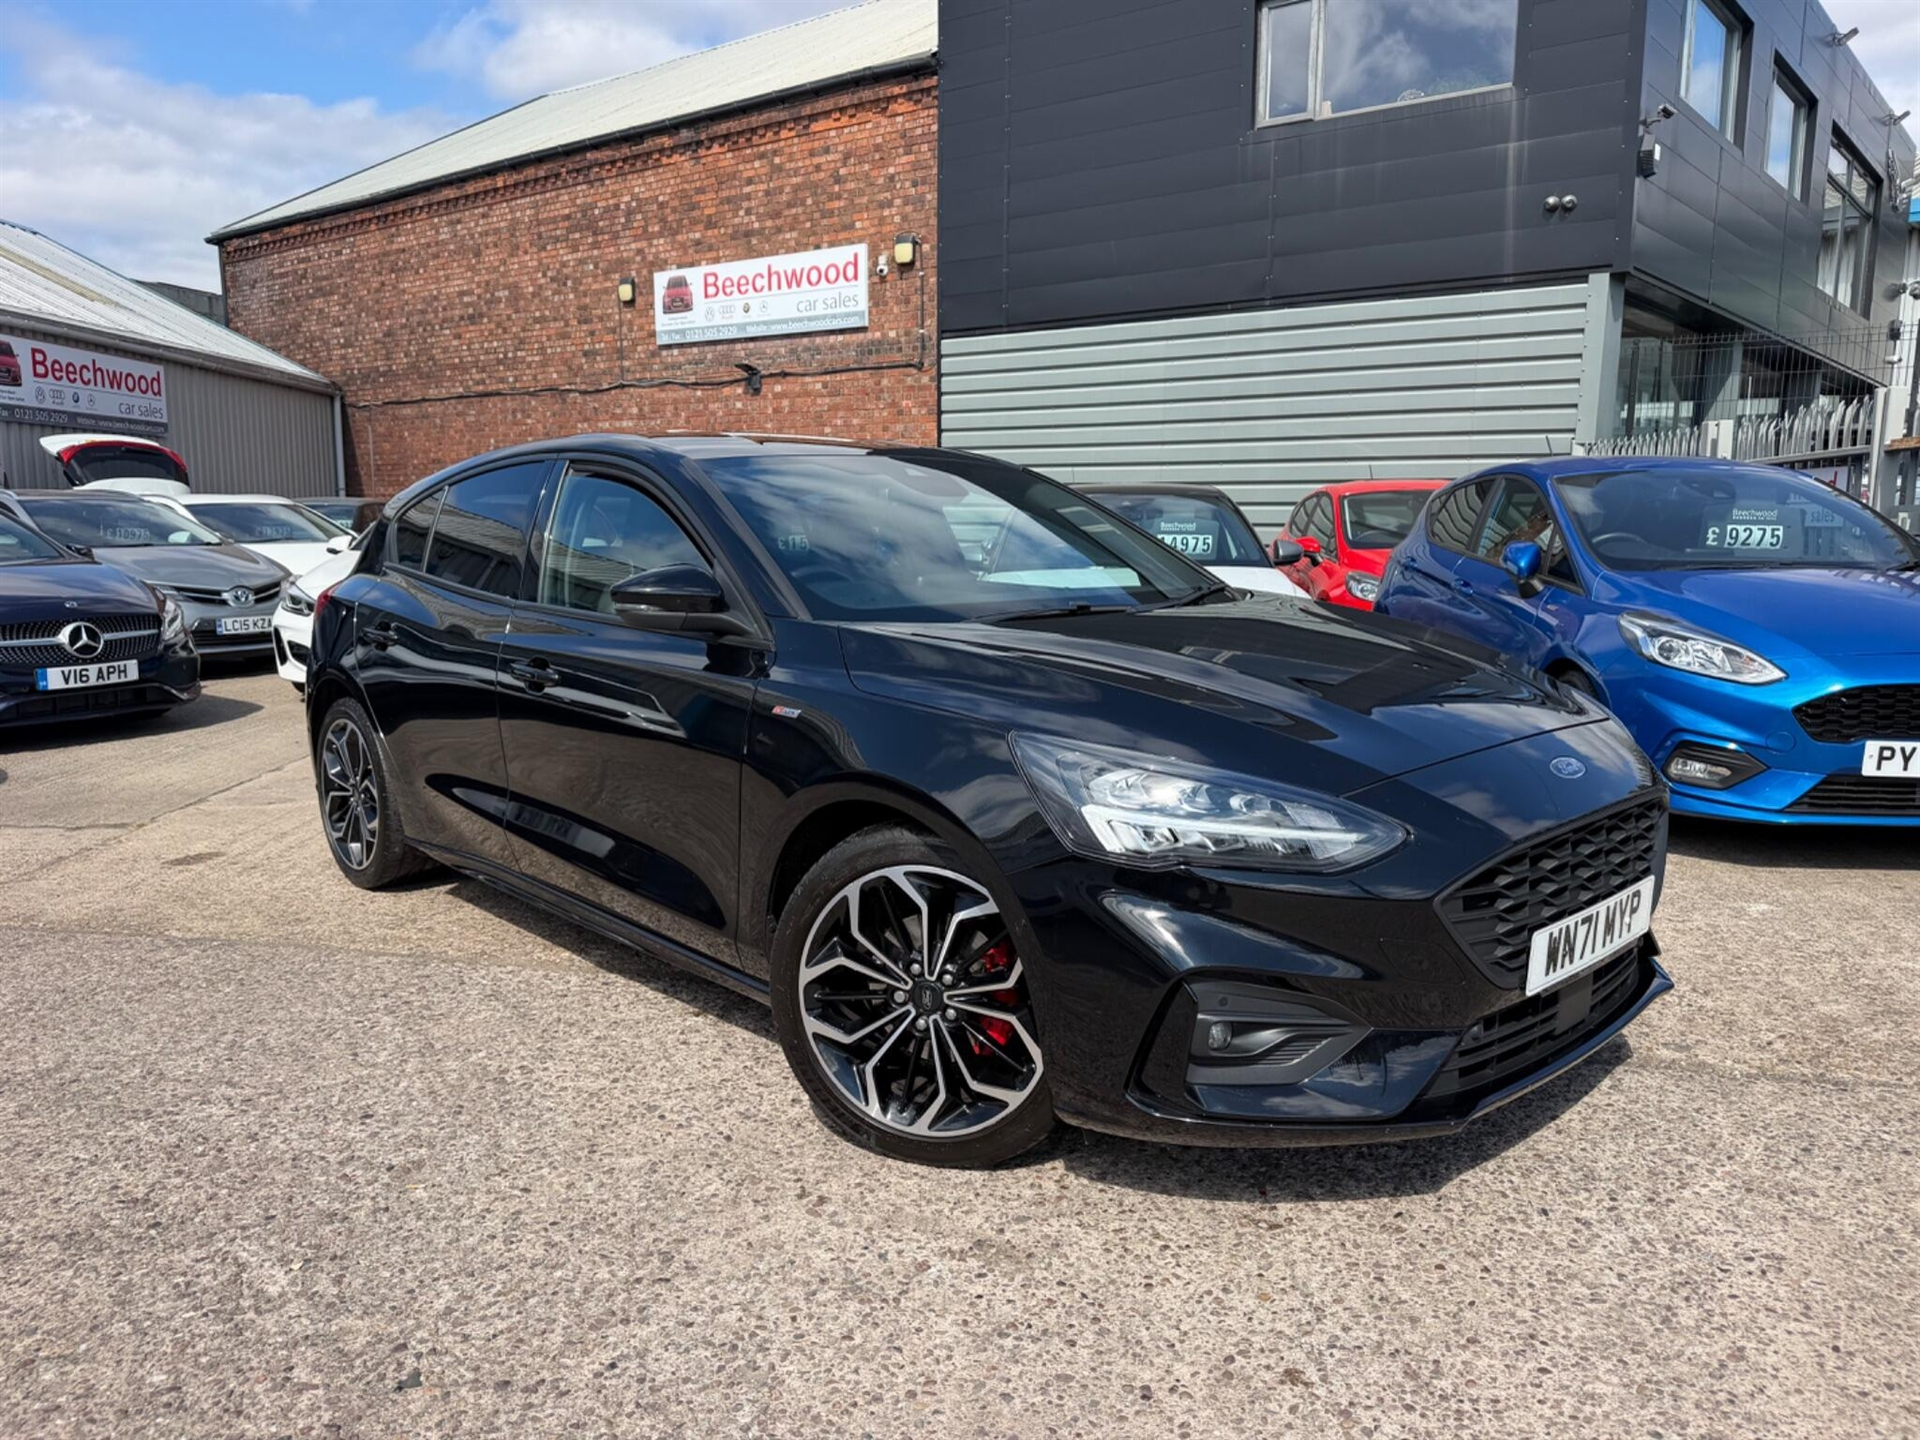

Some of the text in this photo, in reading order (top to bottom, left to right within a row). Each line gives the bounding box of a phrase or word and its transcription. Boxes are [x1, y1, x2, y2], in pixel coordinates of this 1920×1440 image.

[703, 252, 859, 299] Beechwood
[796, 292, 859, 313] car sales
[685, 329, 703, 339] 0121
[704, 328, 718, 338] 505
[719, 326, 737, 336] 2929
[31, 347, 162, 397] Beechwood
[14, 408, 33, 420] 0121
[35, 410, 49, 421] 505
[50, 412, 68, 424] 2929
[118, 401, 164, 420] car sales
[1732, 509, 1778, 517] Beechwood
[1811, 508, 1835, 523] sales
[1706, 526, 1782, 547] £ 9275
[224, 619, 251, 632] LC15
[61, 664, 128, 685] V16 APH
[1876, 745, 1918, 772] PY
[1544, 889, 1641, 977] WN71 MYP
